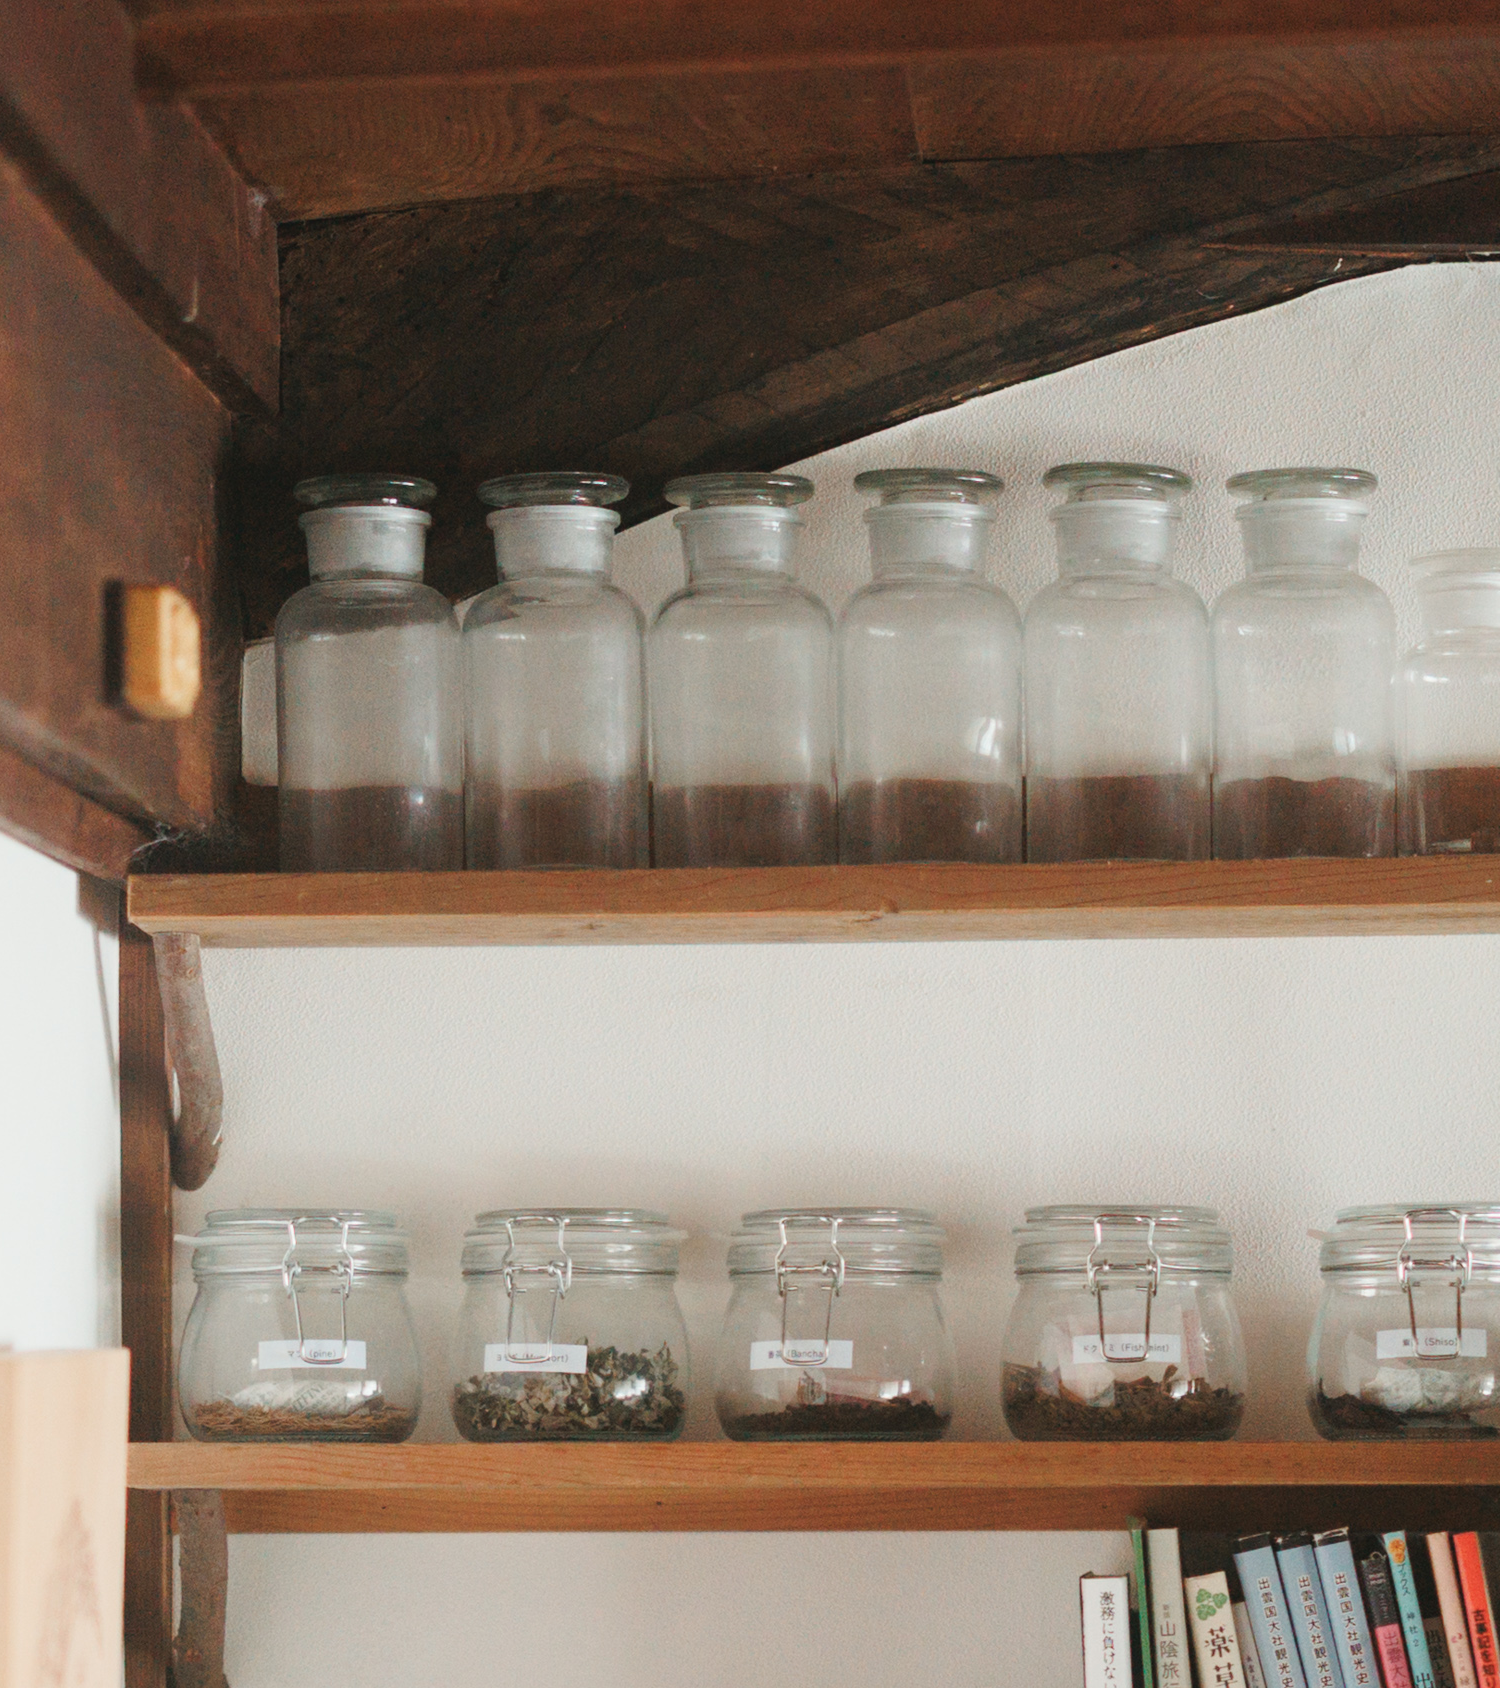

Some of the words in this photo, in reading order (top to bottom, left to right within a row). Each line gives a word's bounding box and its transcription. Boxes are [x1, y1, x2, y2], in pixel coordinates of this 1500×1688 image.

[1083, 1344, 1115, 1353] ドクミ
[309, 1349, 336, 1358] (pine)
[787, 1349, 826, 1358] (Bancha
[1298, 1575, 1334, 1688] 出雲国大社観光史
[1333, 1572, 1370, 1685] 出雲国大社観光史
